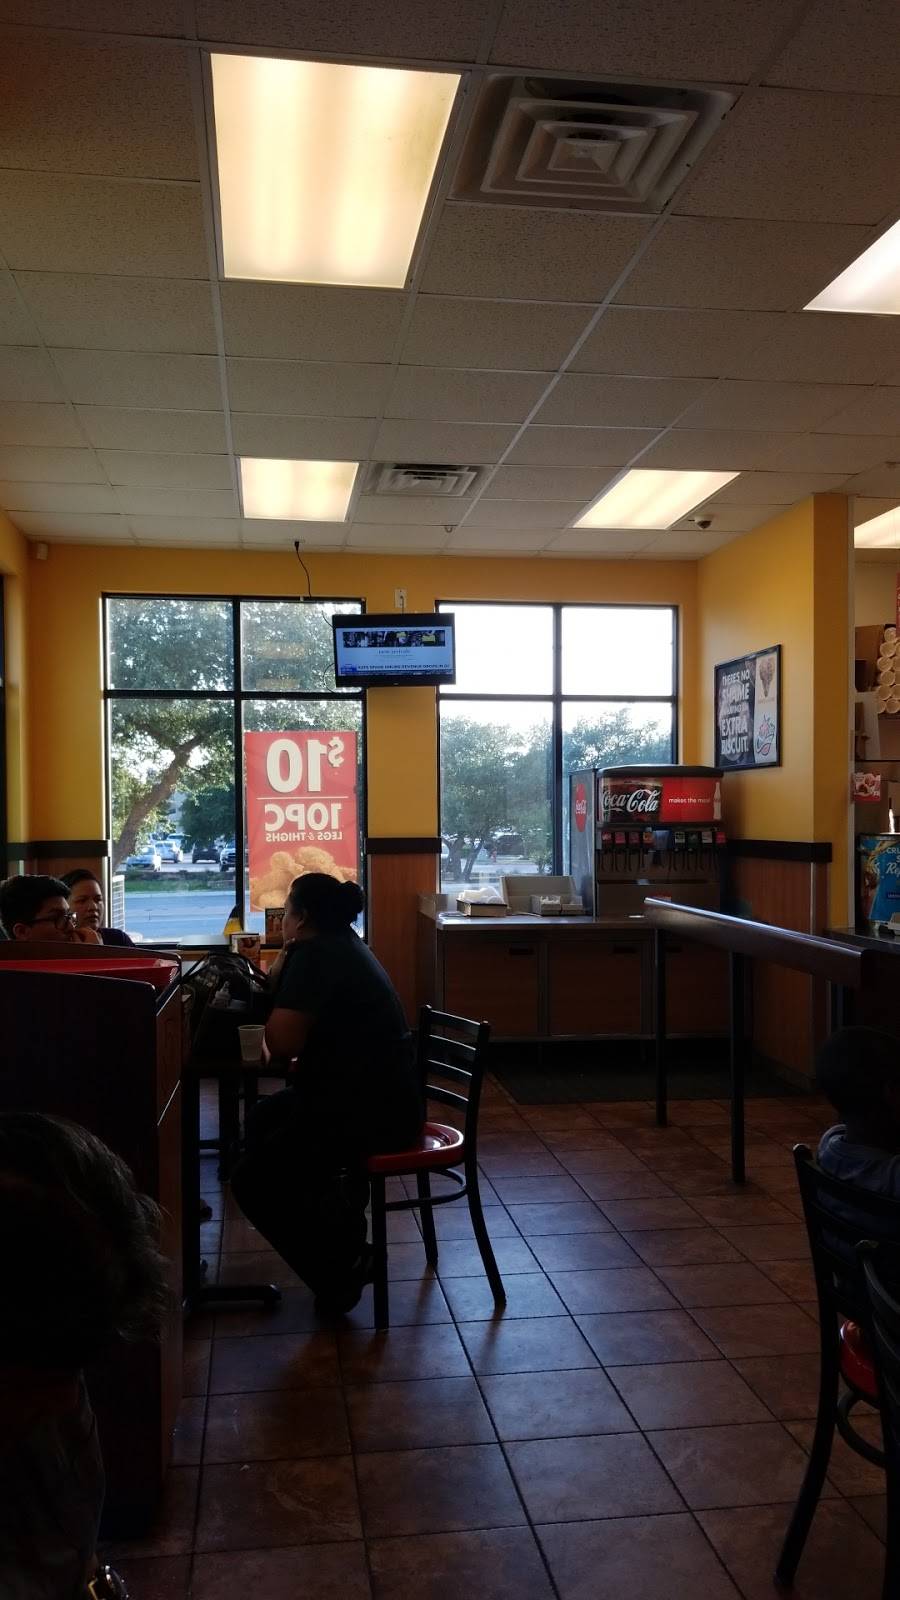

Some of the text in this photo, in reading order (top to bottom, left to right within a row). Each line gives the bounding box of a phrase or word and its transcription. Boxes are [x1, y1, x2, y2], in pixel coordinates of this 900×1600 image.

[722, 669, 750, 688] THERE'S NO
[722, 683, 750, 704] SHAME
[720, 716, 748, 737] EXTRA
[602, 789, 661, 813] Coca-Cola
[687, 796, 697, 804] the
